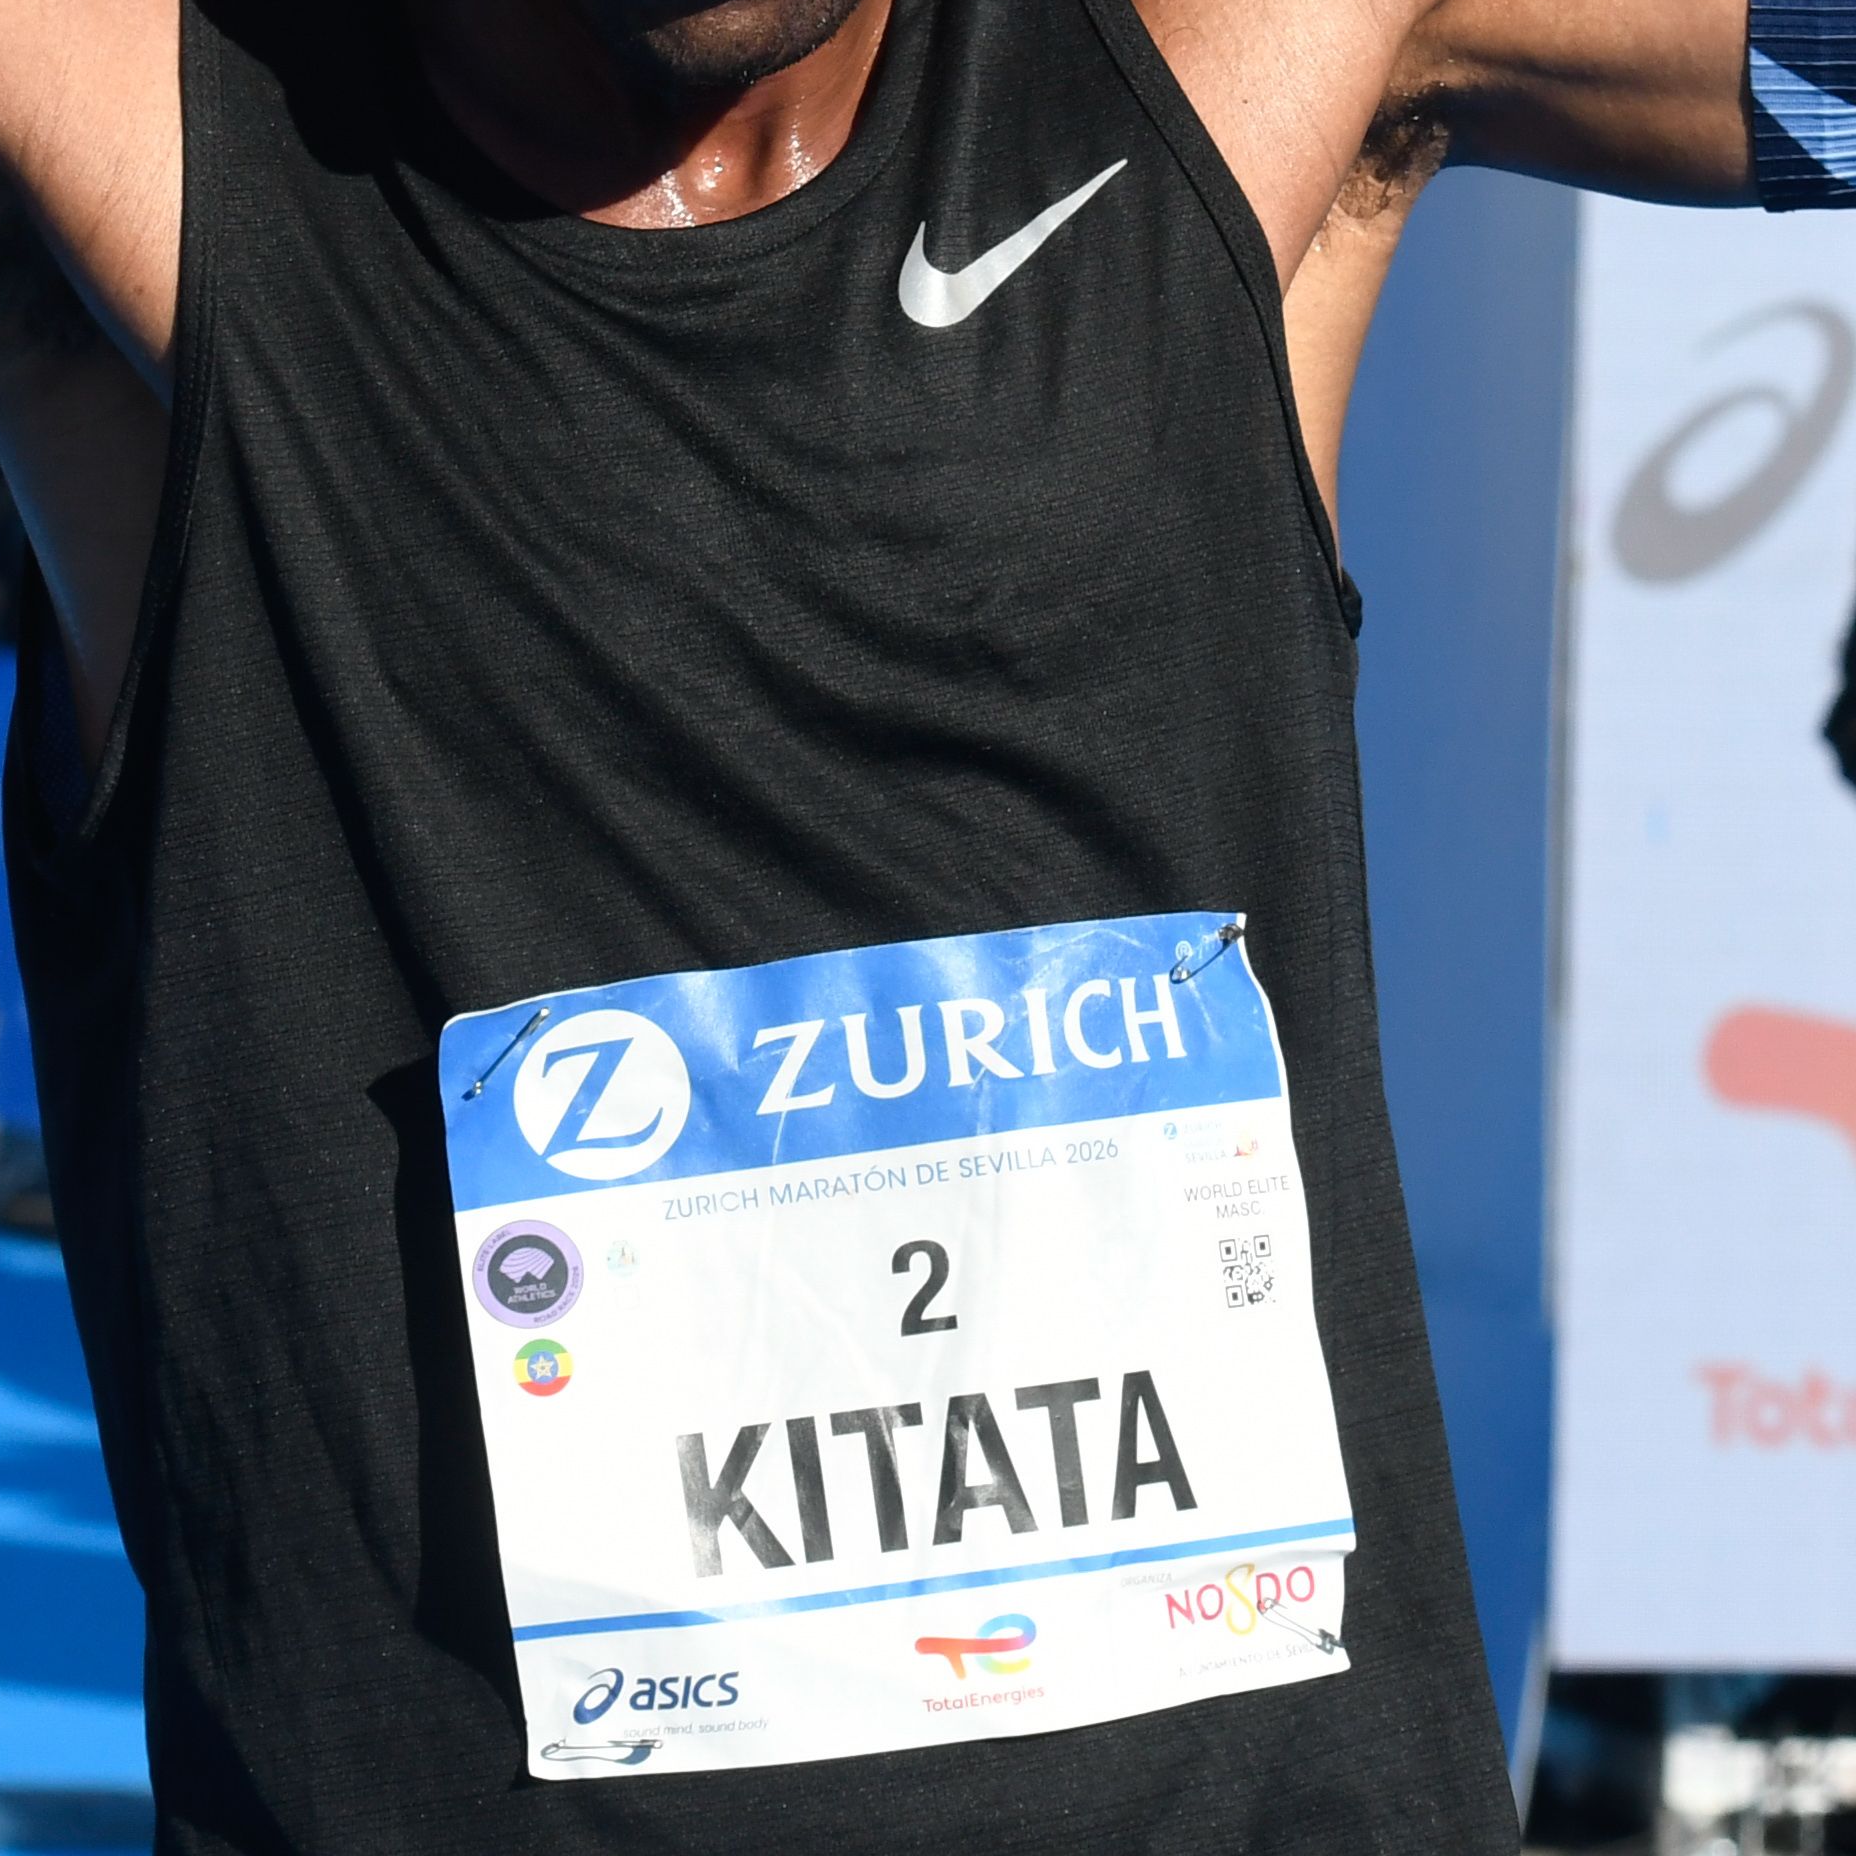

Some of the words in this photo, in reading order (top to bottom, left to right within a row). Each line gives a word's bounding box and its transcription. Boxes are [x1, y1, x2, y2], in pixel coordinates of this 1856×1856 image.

[750, 970, 1189, 1117] ZURICH
[663, 1186, 759, 1221] ZURICH
[769, 1165, 907, 1207] MARATÓN
[916, 1160, 950, 1185] DE
[958, 1146, 1057, 1179] SEVILLA
[1065, 1138, 1120, 1165] 2026
[1183, 1181, 1243, 1203] WORLD
[1247, 1175, 1291, 1195] ELITE
[507, 1291, 556, 1303] ATHLETICS
[513, 1283, 547, 1294] WORLD
[890, 1238, 959, 1338] 2
[534, 1311, 557, 1323] ROAD
[675, 1369, 1198, 1578] KITATA
[1120, 1571, 1173, 1588] ORGANIZA
[628, 1670, 740, 1713] asics
[921, 1684, 1045, 1714] TotalEnergies
[623, 1725, 661, 1740] sound
[697, 1719, 736, 1734] sound
[737, 1716, 770, 1734] body
